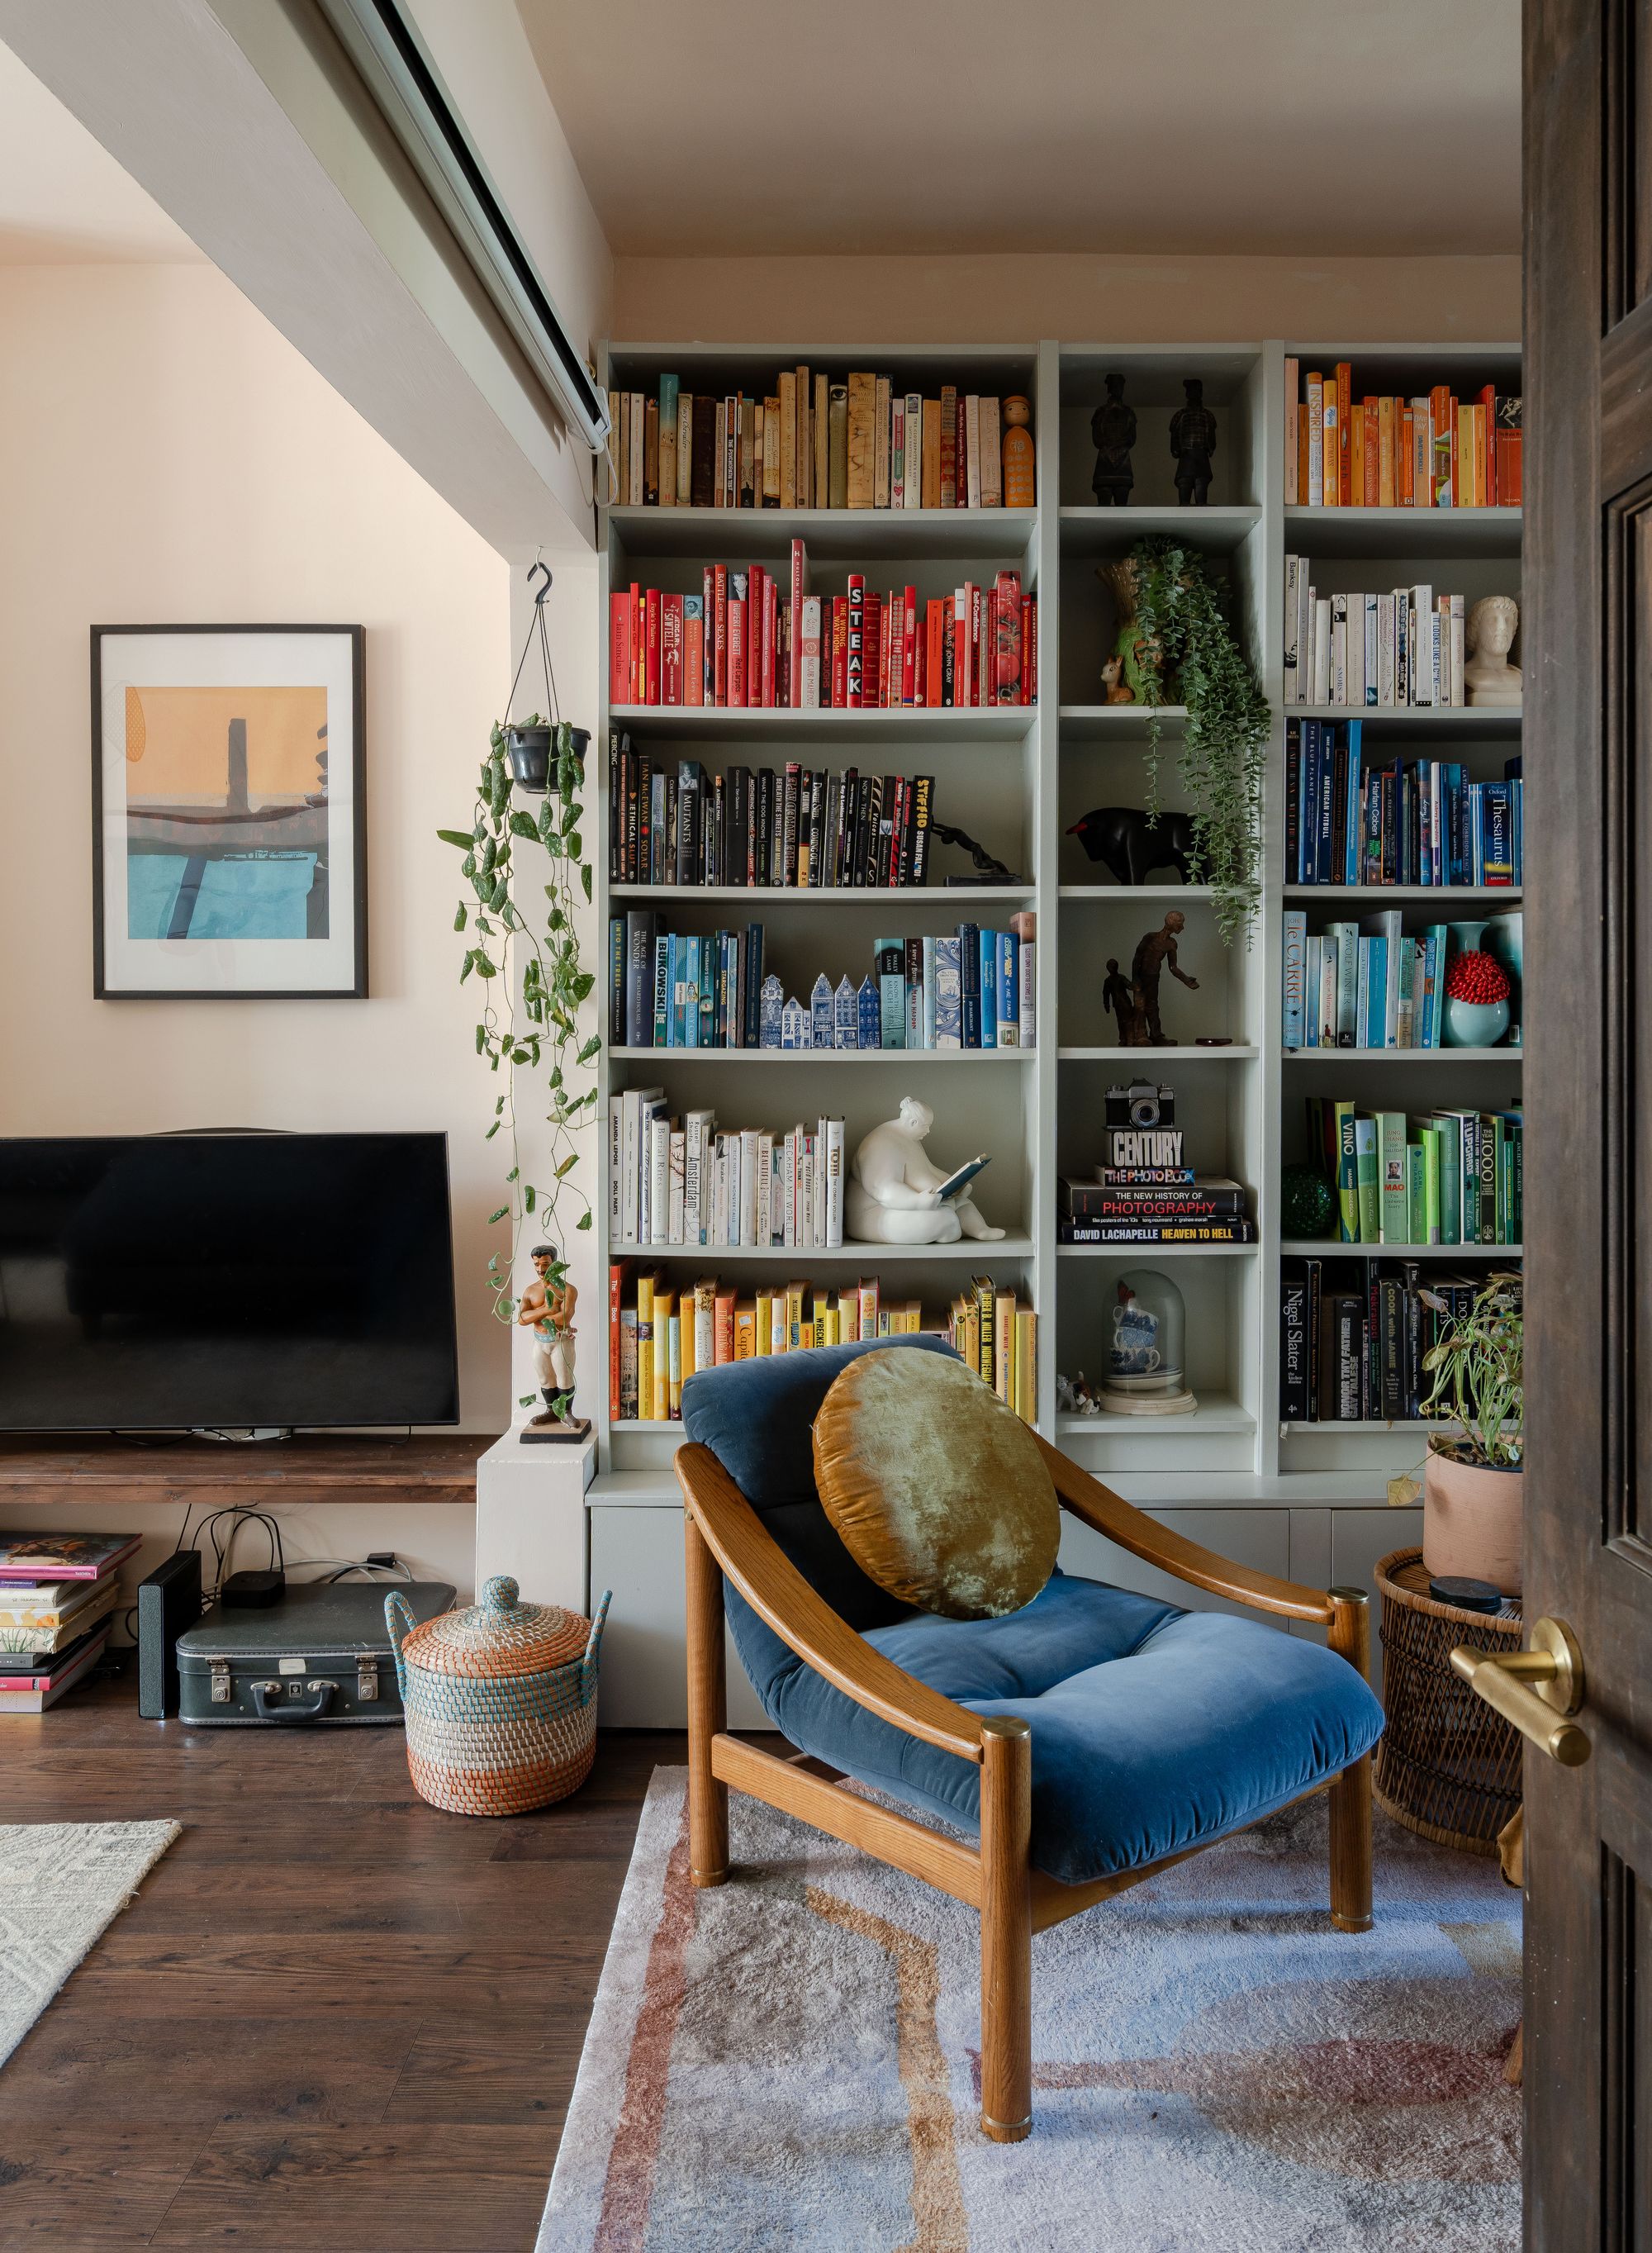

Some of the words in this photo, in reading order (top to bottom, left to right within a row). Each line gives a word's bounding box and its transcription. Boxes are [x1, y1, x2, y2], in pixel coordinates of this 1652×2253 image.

[1310, 387, 1322, 442] INSPIRED
[665, 613, 674, 648] SAWTELLE
[851, 589, 862, 694] STEAK
[785, 777, 797, 801] APE
[683, 794, 692, 843] MUTANTS
[785, 802, 797, 842] NAKED
[1493, 795, 1506, 866] Thesaurus
[785, 845, 797, 868] THE
[916, 830, 924, 853] SUSAN
[1287, 925, 1303, 938] le
[640, 960, 646, 970] OF
[1344, 938, 1353, 965] WOLF
[657, 942, 666, 1010] BUKOWSKI
[1343, 968, 1352, 1005] WINTER
[1114, 1131, 1183, 1167] CENTURY
[1343, 1122, 1354, 1155] VINO
[1464, 1128, 1474, 1176] UPGRADE
[688, 1157, 700, 1208] Amsterdam
[786, 1186, 793, 1199] MY
[1103, 1202, 1216, 1214] PHOTOGRAPHY
[1074, 1229, 1099, 1240] DAVID
[1102, 1229, 1158, 1240] LACHAPELLE
[1162, 1229, 1196, 1239] HEAVEN
[1199, 1229, 1210, 1238] TO
[1212, 1229, 1233, 1238] HELL
[718, 1309, 727, 1324] THE
[982, 1293, 992, 1312] DEREK
[1283, 1289, 1303, 1326] Nigel
[718, 1326, 727, 1350] FLYING
[982, 1321, 992, 1342] MILLER
[1341, 1317, 1350, 1356] FATHER
[982, 1345, 992, 1381] NORWEGIAN
[1288, 1330, 1303, 1370] Slater
[1341, 1358, 1350, 1379] THY
[1350, 1356, 1358, 1397] TALESE
[1341, 1380, 1350, 1418] HONOR
[1350, 1398, 1358, 1419] GAY
